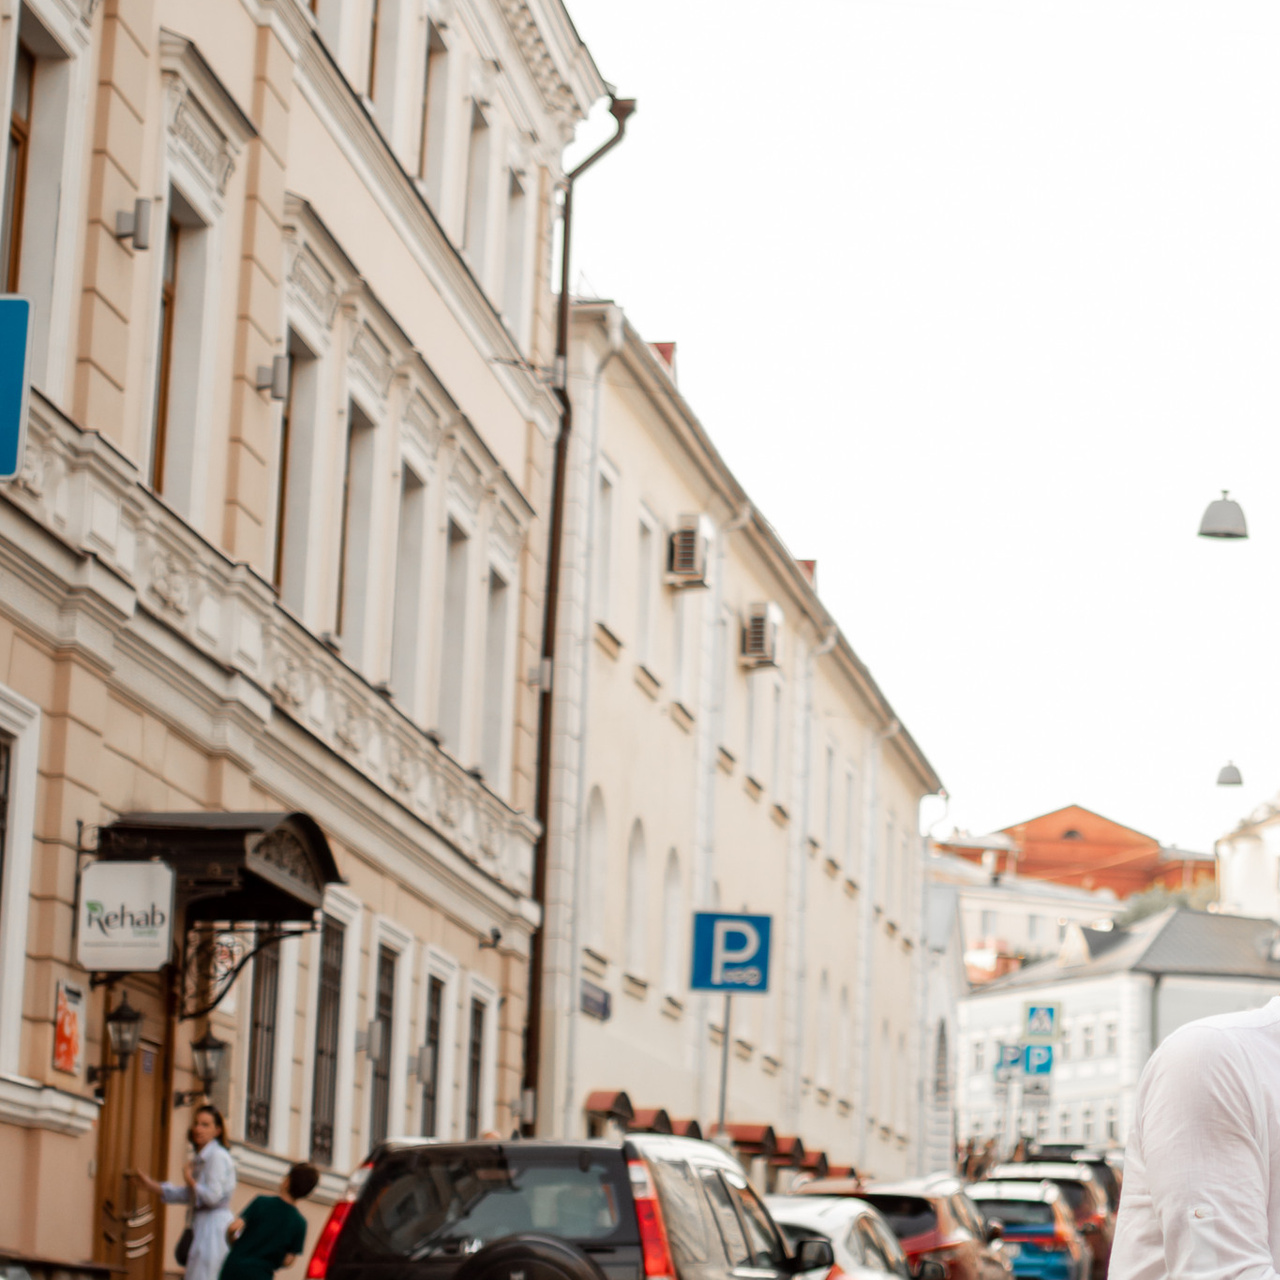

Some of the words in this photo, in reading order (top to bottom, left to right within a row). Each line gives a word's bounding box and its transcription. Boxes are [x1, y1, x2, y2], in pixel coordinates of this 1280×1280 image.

[87, 901, 165, 936] Rehab
[711, 920, 761, 985] P
[1029, 1046, 1050, 1073] P
